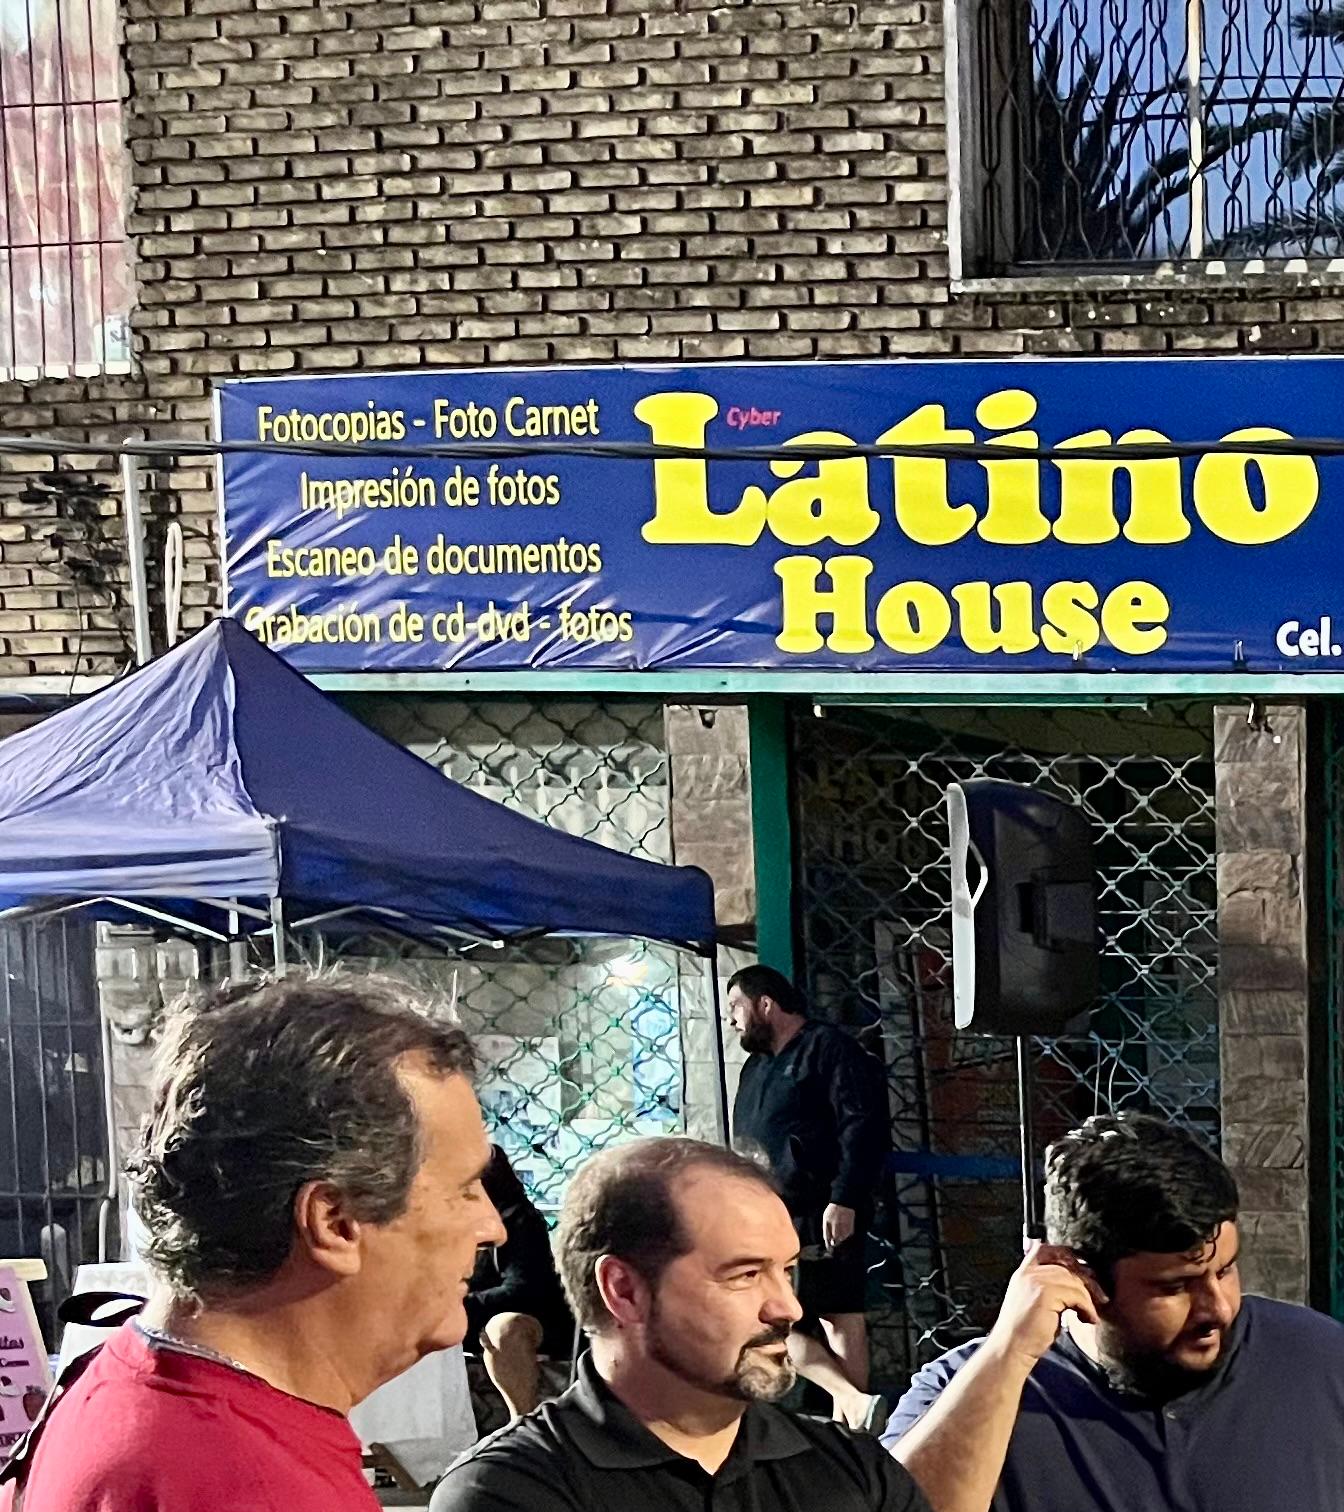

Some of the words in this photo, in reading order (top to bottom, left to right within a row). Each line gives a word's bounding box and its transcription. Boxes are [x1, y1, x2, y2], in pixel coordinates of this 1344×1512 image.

[258, 401, 405, 443] Fotocopias
[434, 399, 498, 439] Foto
[504, 396, 600, 438] Carnet
[725, 405, 782, 428] Cyber
[633, 388, 1319, 546] Latino
[300, 466, 436, 519] Impresión
[443, 466, 480, 507] de
[487, 463, 561, 507] fotos
[267, 539, 376, 578] Escaneo
[384, 535, 419, 576] de
[427, 534, 602, 576] documentos
[245, 602, 380, 644] Grabación
[388, 602, 424, 643] de
[431, 601, 530, 643] cd-dvd
[560, 602, 633, 643] fotos
[773, 554, 1170, 654] House
[1276, 616, 1342, 657] Cel.
